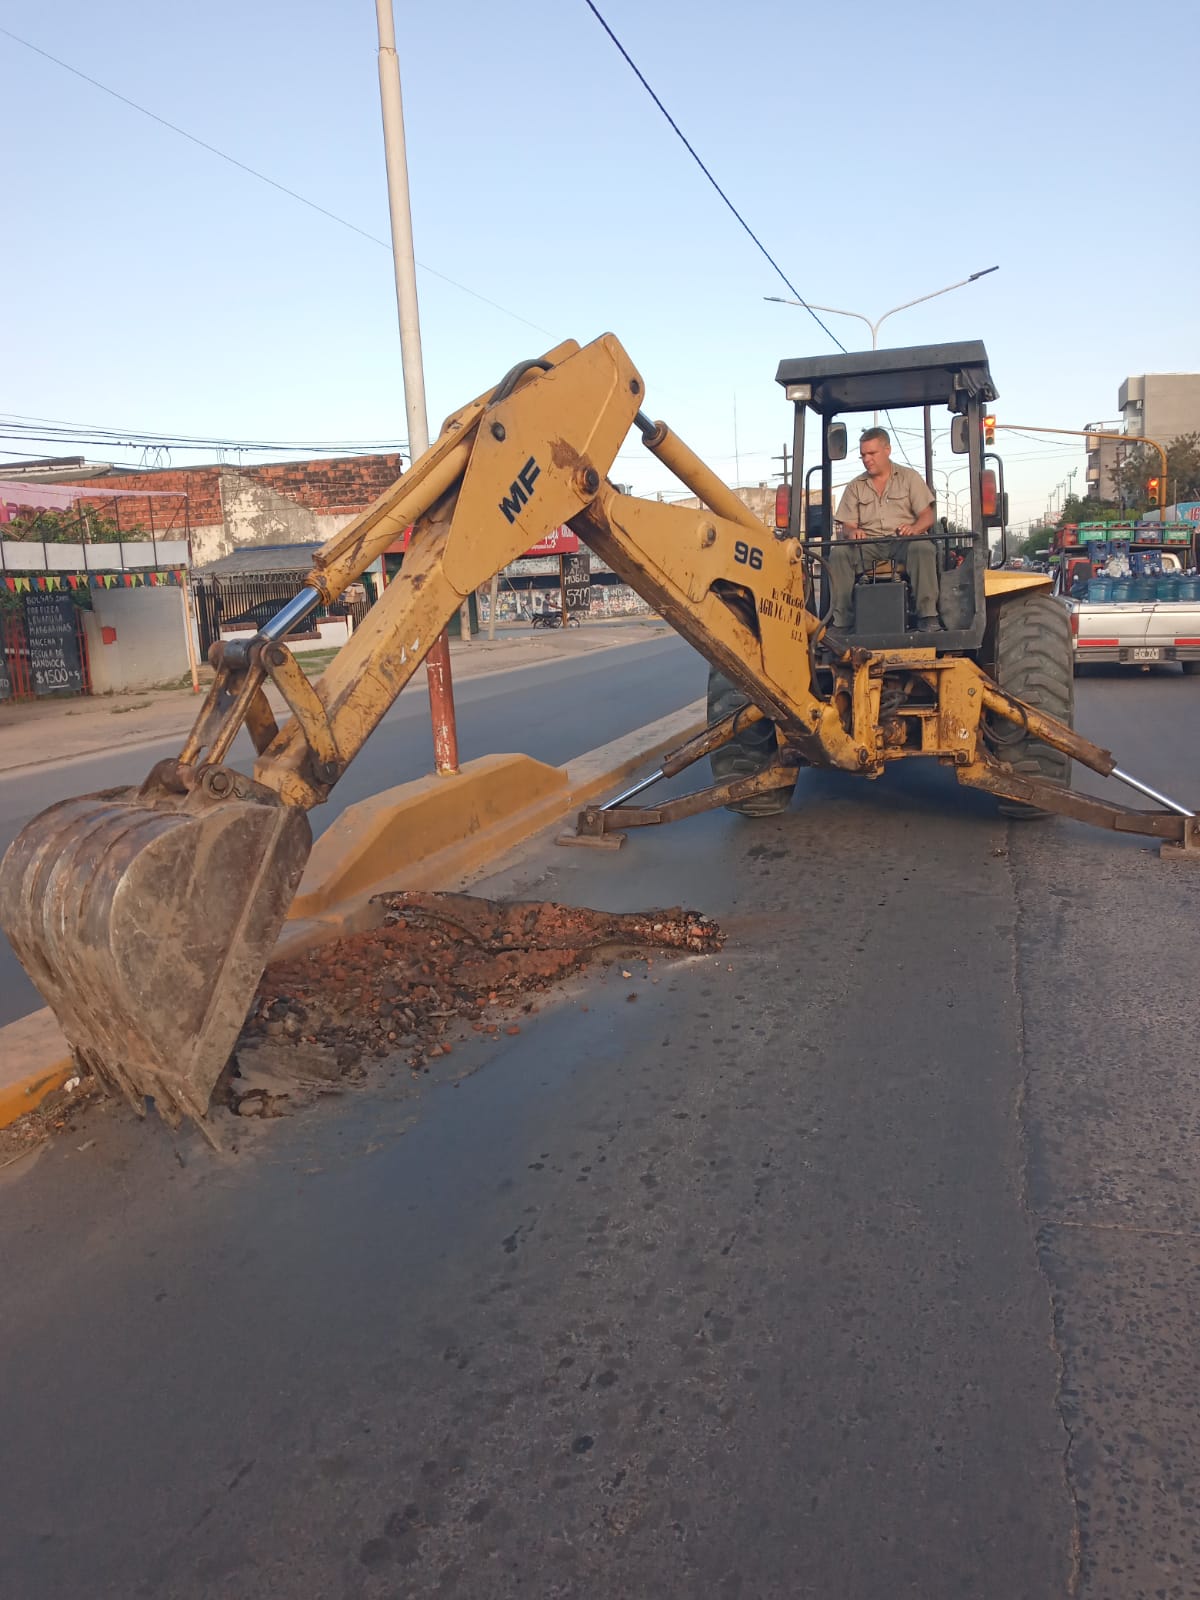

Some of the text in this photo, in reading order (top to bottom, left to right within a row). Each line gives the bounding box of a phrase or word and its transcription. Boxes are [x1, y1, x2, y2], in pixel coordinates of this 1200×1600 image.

[499, 456, 541, 524] MF
[734, 541, 763, 570] 96
[32, 658, 66, 669] MANDIOCA
[35, 668, 69, 685] $1500
